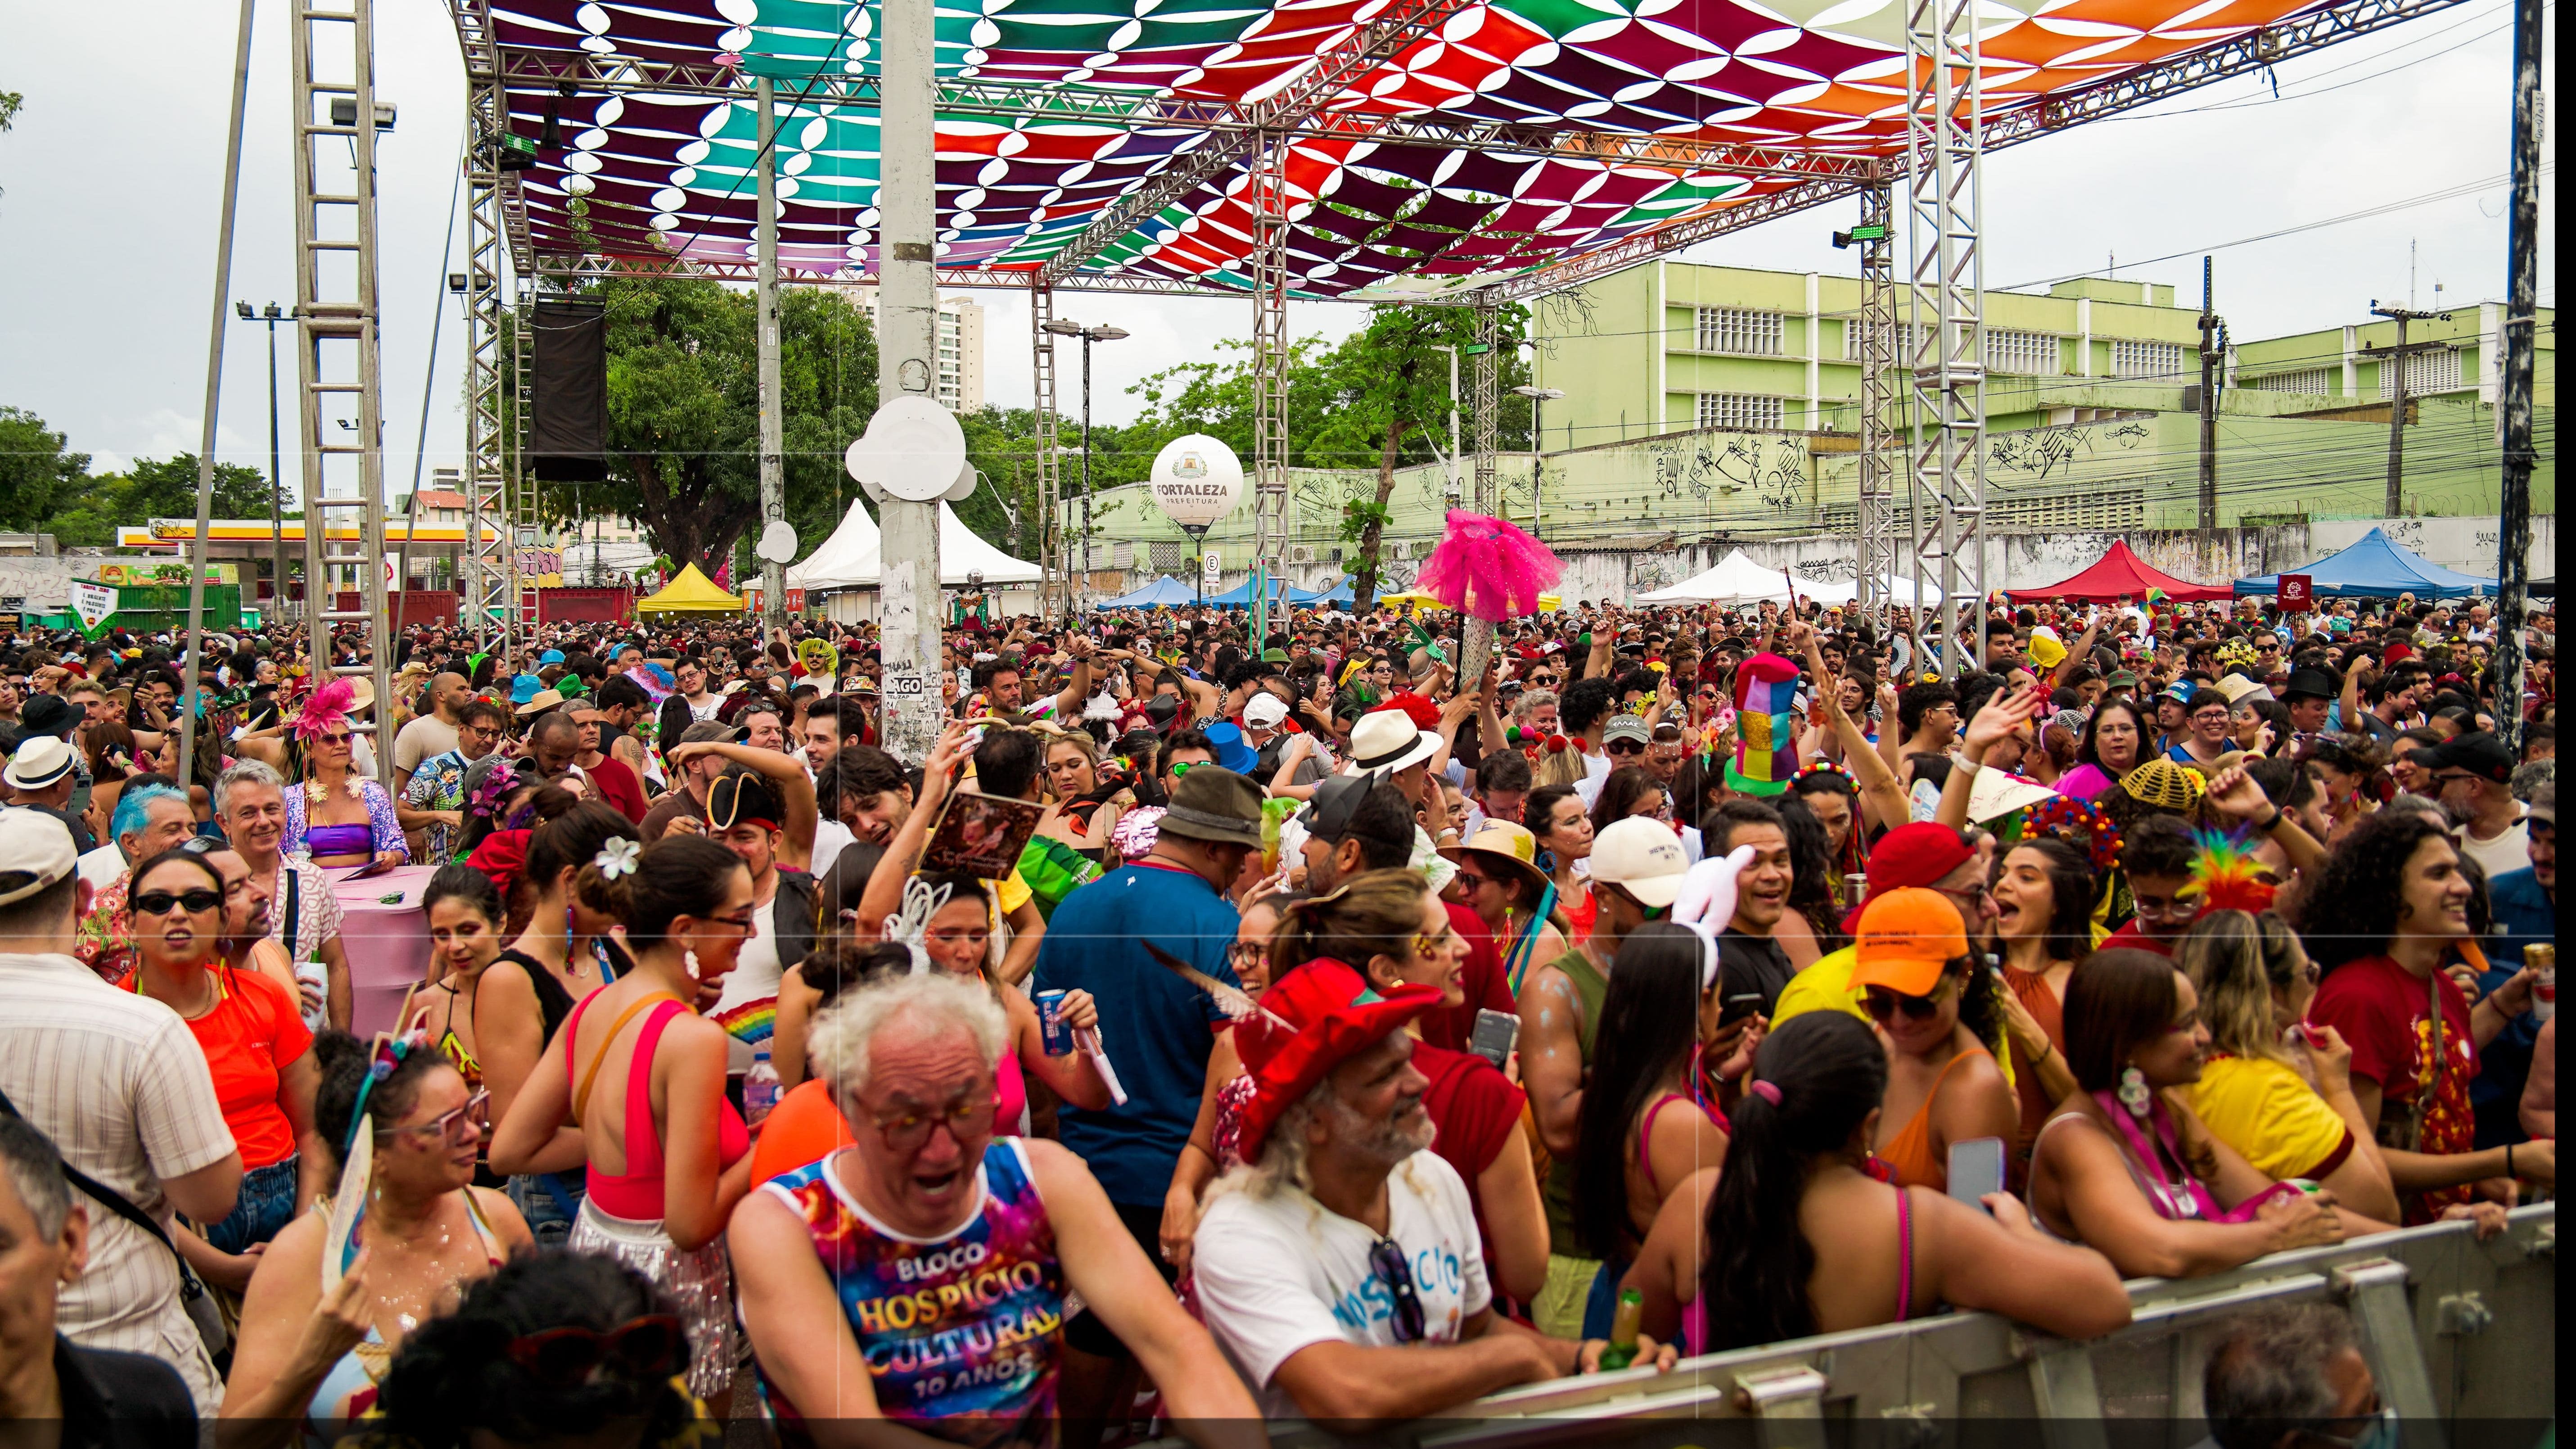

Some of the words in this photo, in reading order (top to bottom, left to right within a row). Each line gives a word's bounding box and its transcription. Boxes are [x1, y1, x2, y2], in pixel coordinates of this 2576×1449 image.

[1157, 484, 1227, 496] FORTALEZA
[1210, 559, 1214, 568] E
[1043, 1001, 1056, 1039] BEATS
[896, 1242, 987, 1282] BLOCO
[856, 1260, 1042, 1335] HOSPÍCIO
[864, 1305, 1060, 1376] CULTURAL
[913, 1376, 946, 1399] 10
[953, 1352, 1034, 1390] ANOS
